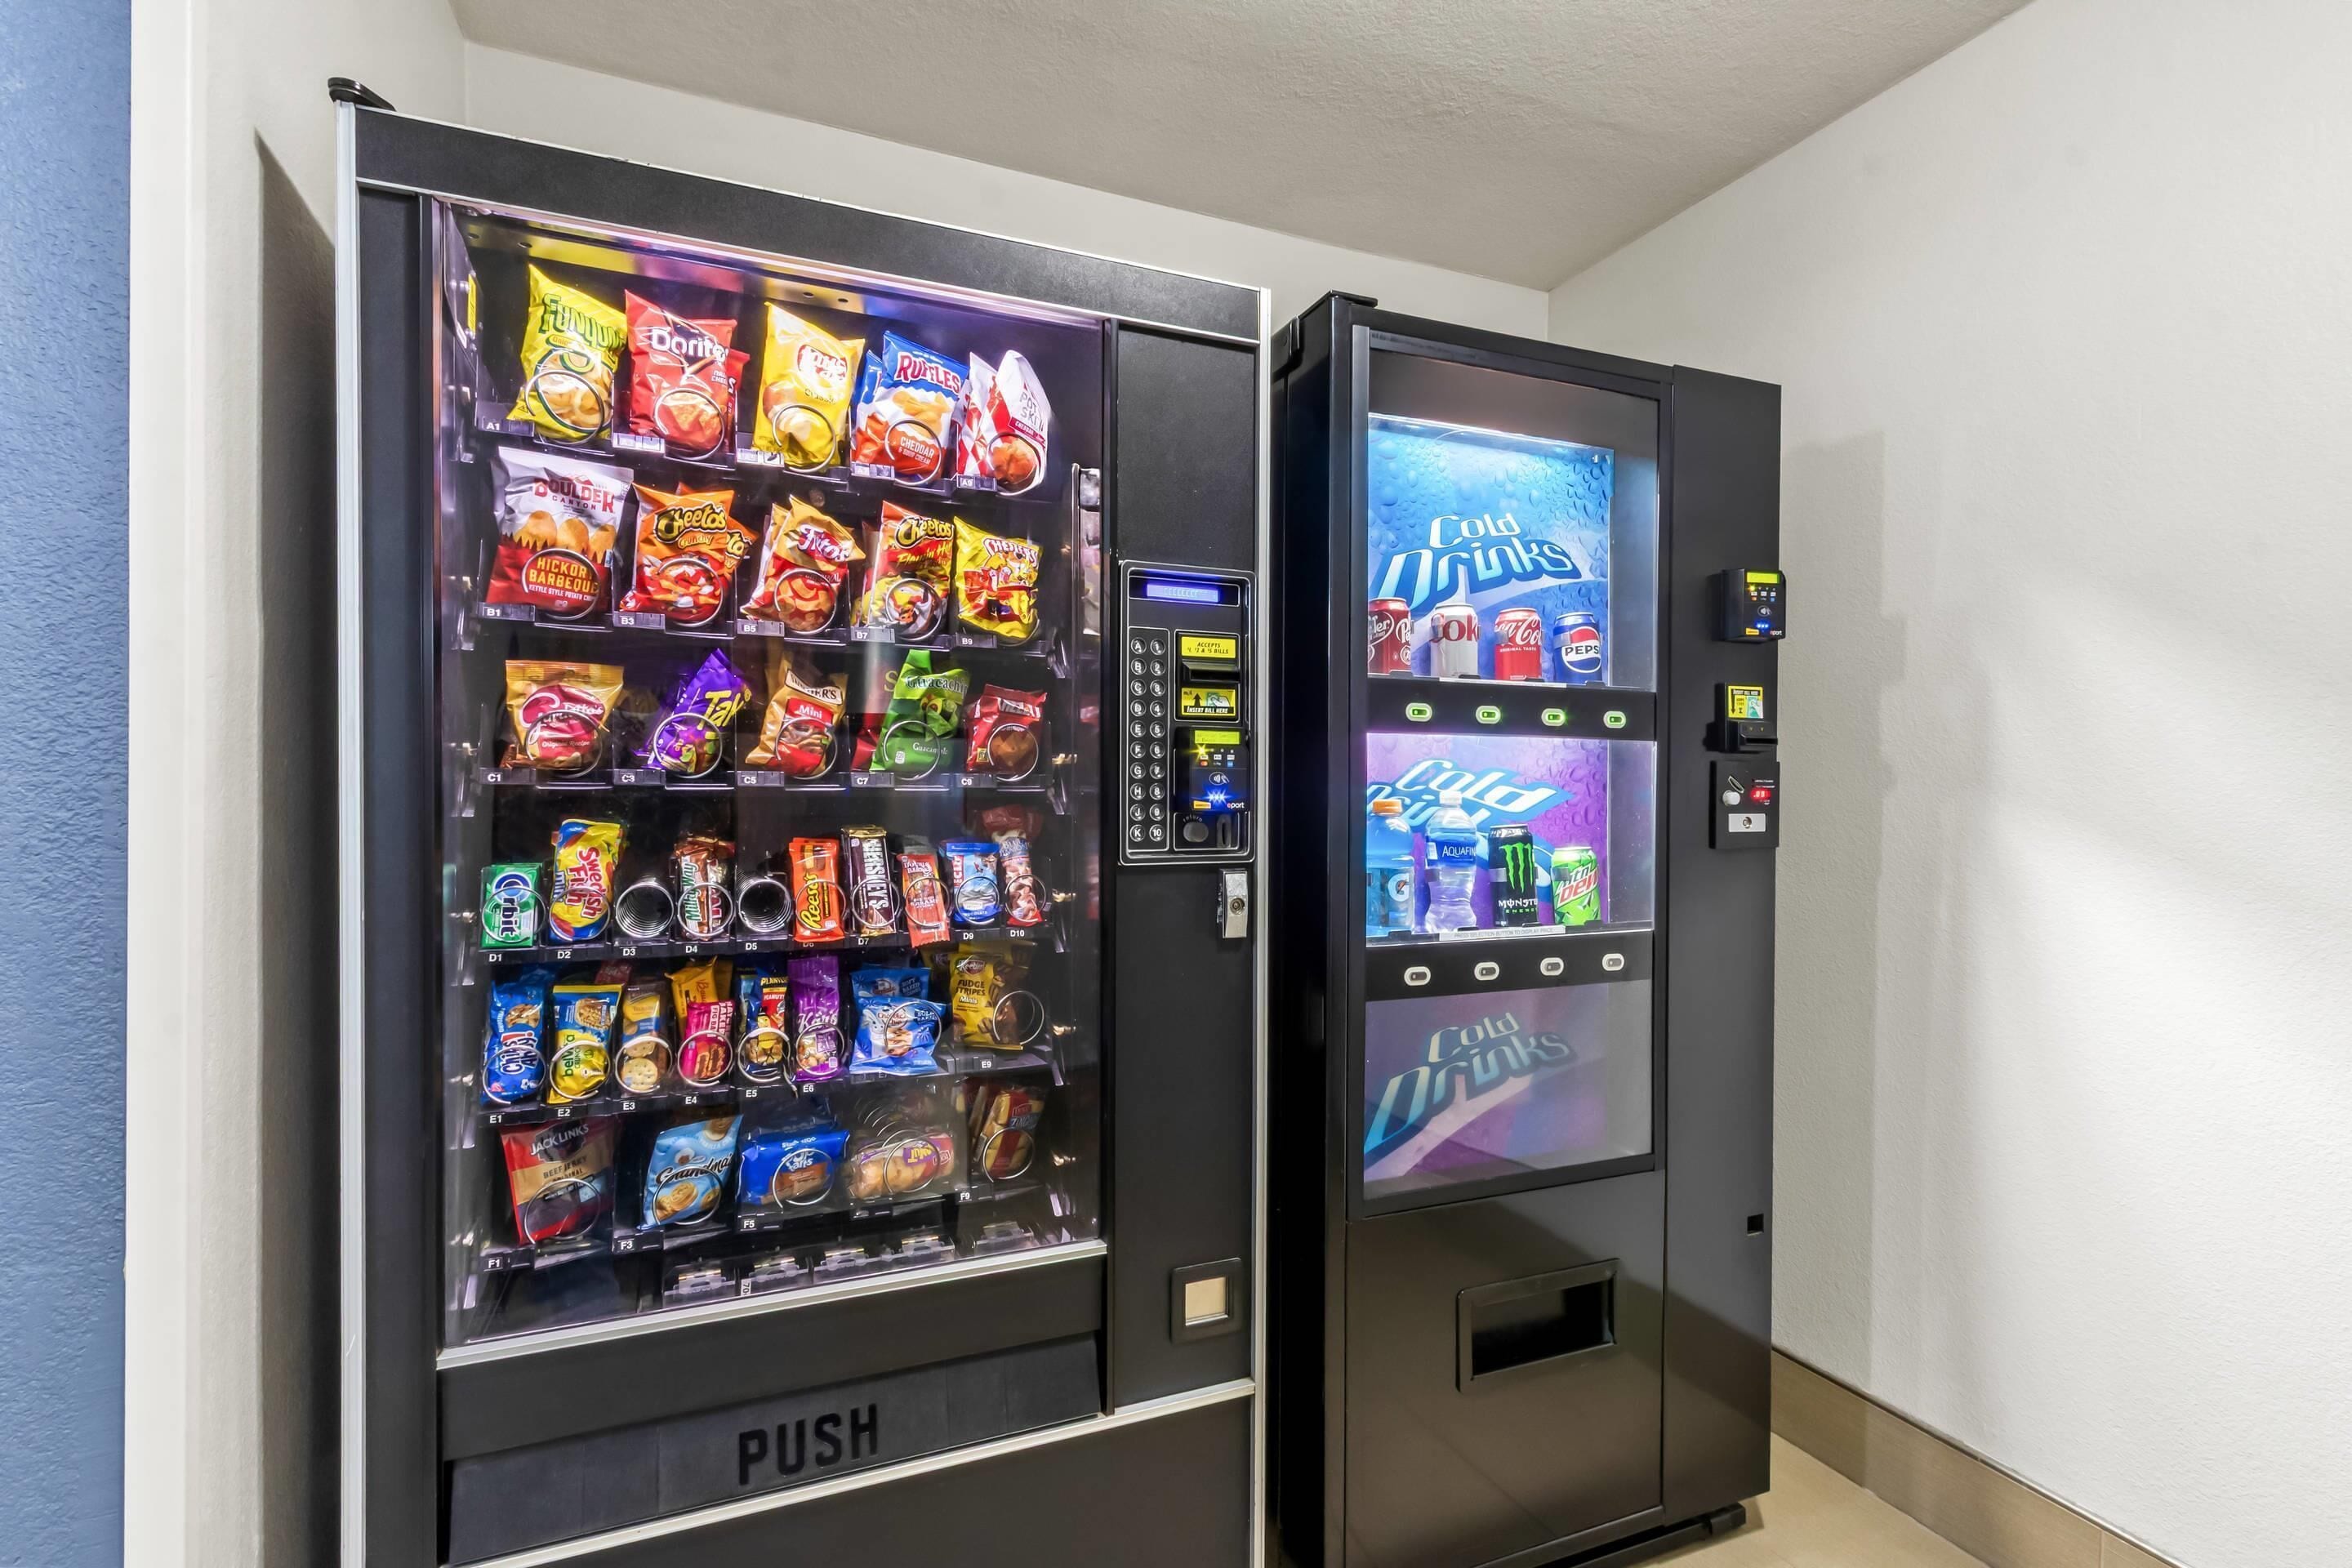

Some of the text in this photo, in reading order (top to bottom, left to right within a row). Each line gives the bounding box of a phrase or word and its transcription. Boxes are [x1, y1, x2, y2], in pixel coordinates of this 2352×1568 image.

[894, 354, 961, 394] RUFFLES
[486, 422, 501, 431] A1
[900, 436, 935, 457] CHEDDAR
[903, 448, 915, 459] SOUR
[915, 452, 931, 466] CREAM
[961, 478, 973, 488] A9
[552, 495, 596, 510] CANYON
[657, 503, 727, 540] Cheetos
[898, 518, 952, 546] Cheetos
[1429, 513, 1521, 549] Cold
[678, 534, 713, 549] Crunchy
[797, 523, 850, 562] Fritos
[1378, 537, 1574, 611] Drinks
[529, 569, 599, 594] BARBEQUE
[529, 585, 583, 600] KETTLE STYLE POTATO
[487, 608, 501, 617] B1
[621, 617, 635, 626] B3
[744, 624, 756, 632] B5
[857, 630, 868, 639] B7
[961, 636, 973, 645] B9
[1134, 642, 1142, 650] A
[1155, 643, 1160, 651] 1
[1134, 662, 1142, 670] B
[1155, 663, 1160, 671] 2
[1134, 683, 1142, 692] C
[799, 705, 822, 719] Mini
[1134, 705, 1142, 713] D
[1154, 705, 1160, 713] 4
[1134, 725, 1141, 733] E
[1154, 725, 1160, 733] 5
[1134, 746, 1141, 754] F
[1154, 746, 1160, 754] 6
[1134, 766, 1142, 775] G
[487, 773, 501, 782] C1
[621, 773, 635, 782] C3
[744, 776, 756, 785] C5
[857, 777, 868, 786] C7
[961, 777, 973, 786] C9
[1134, 787, 1142, 795] H
[1154, 787, 1160, 795] 8
[1395, 759, 1557, 814] Cold
[1227, 802, 1245, 810] eport
[1135, 808, 1141, 817] J
[1134, 829, 1142, 837] K
[1152, 828, 1162, 837] 10
[1442, 844, 1477, 858] AQUAFIN
[566, 865, 589, 905] Fish
[577, 847, 608, 918] Swedish
[681, 862, 702, 921] Milky Way
[493, 872, 531, 937] Orbit
[800, 873, 822, 929] Reese's
[963, 932, 974, 940] D9
[1009, 929, 1025, 938] D10
[745, 942, 757, 951] D5
[858, 938, 869, 946] D7
[622, 947, 635, 956] D3
[685, 945, 698, 954] D4
[489, 953, 502, 962] D1
[557, 951, 571, 960] D2
[957, 980, 985, 988] FUDGE
[956, 987, 986, 996] STRIPES
[960, 996, 978, 1004] Minis
[1428, 1012, 1521, 1062] Cold
[981, 1060, 991, 1068] E9
[745, 1089, 758, 1098] E5
[803, 1085, 814, 1093] E6
[1364, 1033, 1570, 1155] Drinks
[685, 1096, 697, 1104] E4
[622, 1102, 635, 1110] E3
[557, 1108, 570, 1116] E2
[489, 1115, 502, 1123] E1
[531, 1135, 559, 1156] JACK
[543, 1156, 587, 1178] BEEF JERKY
[960, 1192, 970, 1200] F9
[743, 1220, 755, 1228] F5
[621, 1241, 632, 1250] F3
[488, 1259, 501, 1268] F1
[738, 1403, 878, 1486] PUSH
